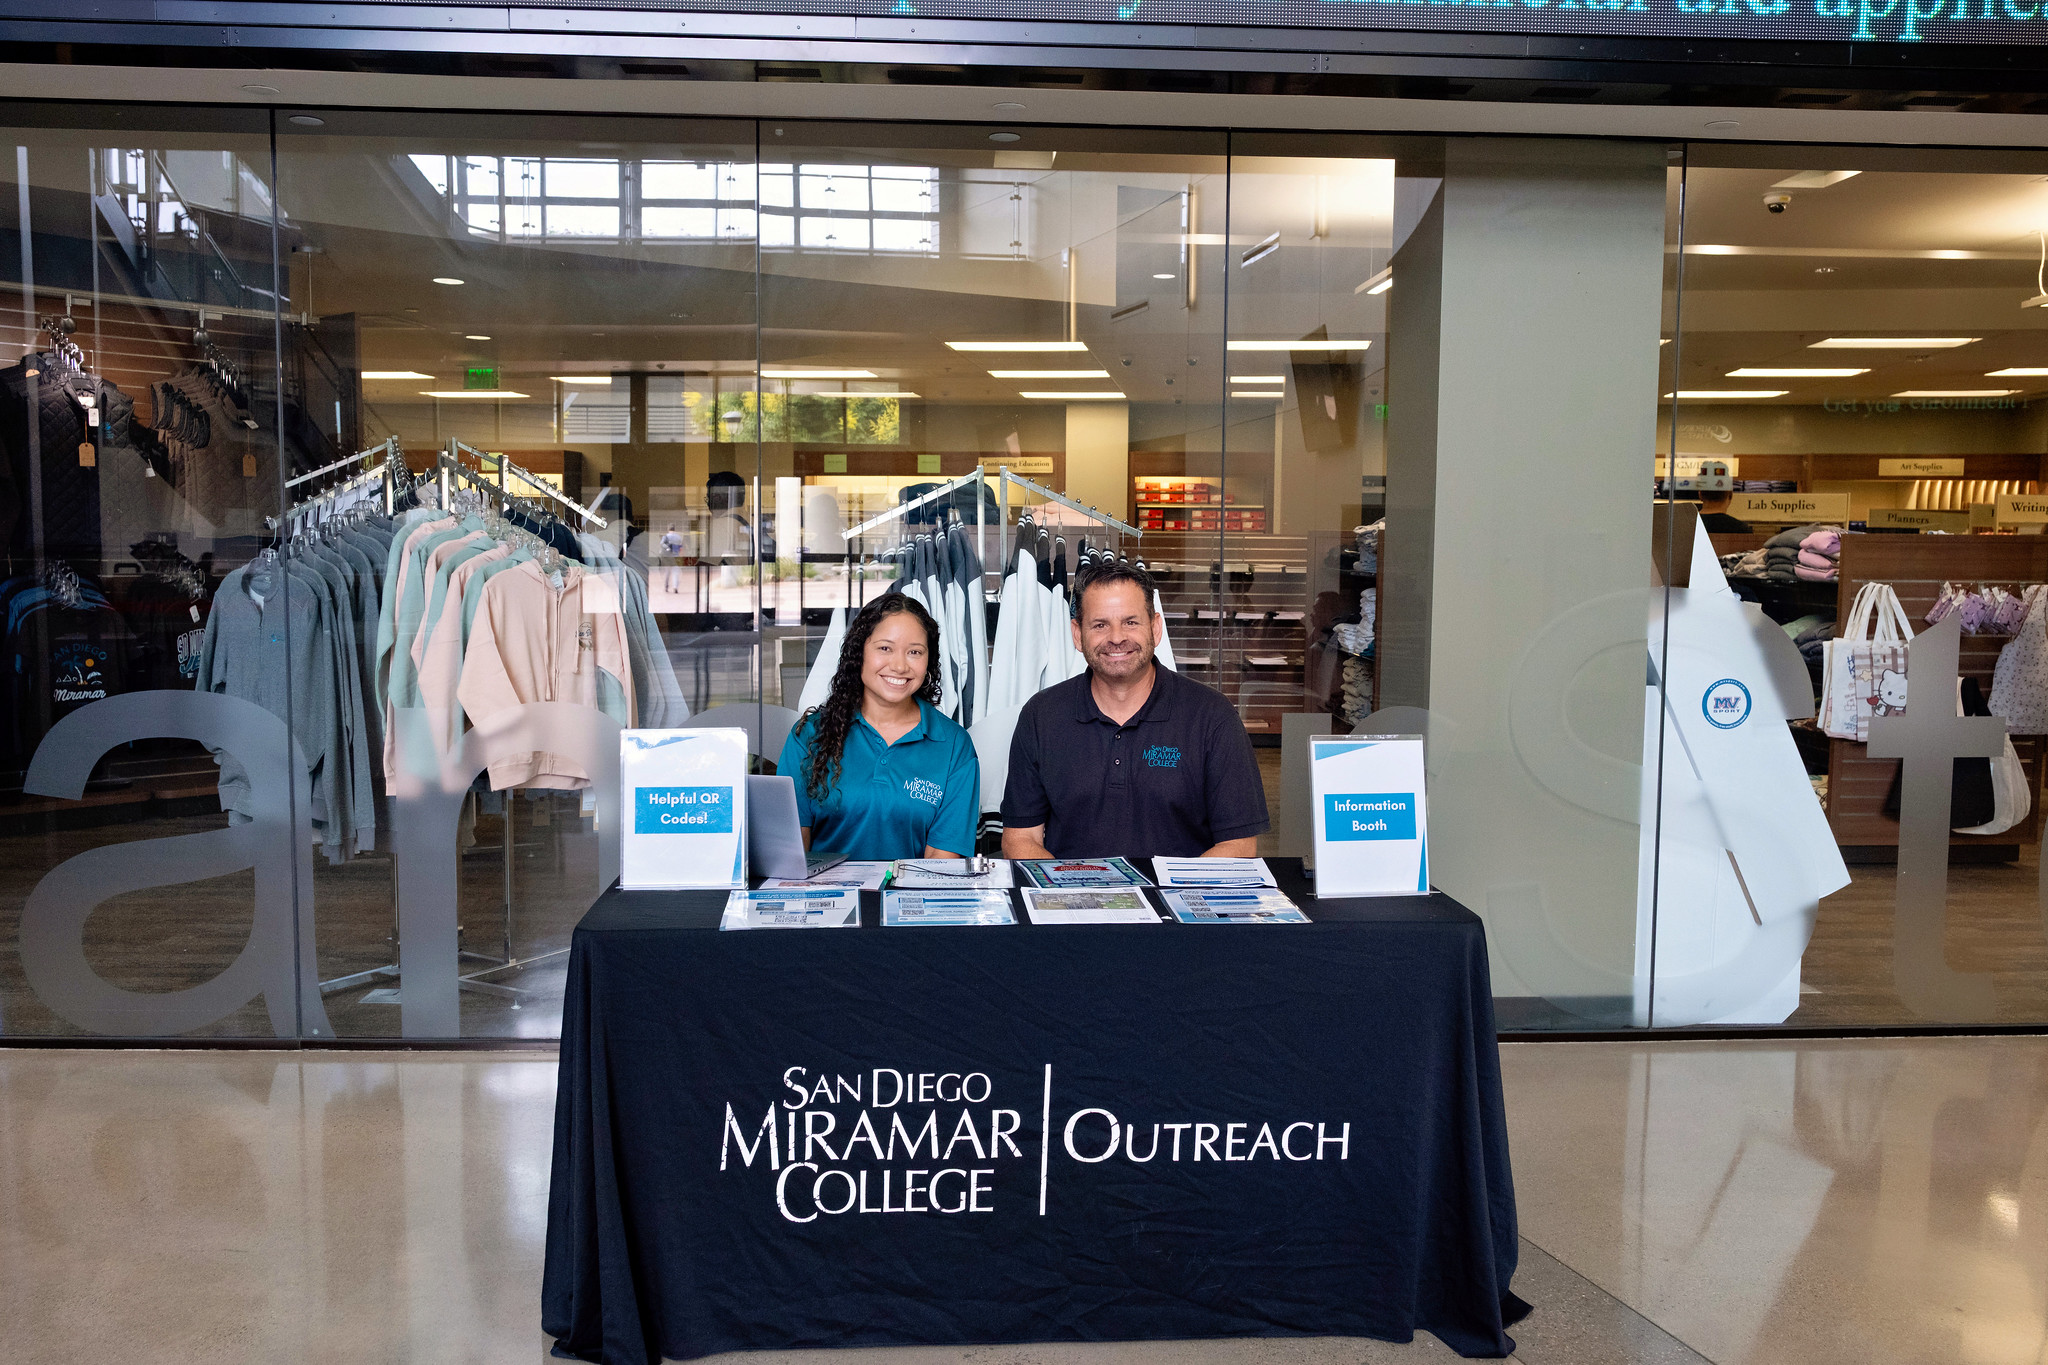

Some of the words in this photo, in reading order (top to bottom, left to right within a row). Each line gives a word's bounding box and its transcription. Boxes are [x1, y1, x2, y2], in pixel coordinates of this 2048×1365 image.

[981, 460, 1018, 469] Continuing
[1018, 460, 1050, 468] Education
[1900, 463, 1911, 471] Art
[1913, 463, 1943, 472] Supplies
[1747, 499, 1767, 510] Lab
[1770, 499, 1816, 513] Supplies
[1887, 513, 1930, 525] Planners
[72, 643, 107, 660] DIEGO
[53, 688, 107, 702] Miramar
[1713, 697, 1741, 709] MV
[1142, 749, 1182, 760] MIRAMAR
[1148, 759, 1178, 768] COLLEGE
[903, 780, 943, 799] MIRAMAR
[914, 776, 925, 785] SAN
[925, 780, 941, 791] DIEGO
[649, 792, 697, 808] Helpful
[700, 792, 720, 804] QR
[910, 790, 938, 806] COLLEGE
[1334, 799, 1406, 812] Information
[660, 812, 708, 825] Codes!
[1352, 818, 1388, 831] Booth
[782, 1066, 862, 1111] SAN
[871, 1068, 992, 1109] DIEGO
[720, 1101, 1022, 1171] MIRAMAR
[1062, 1106, 1351, 1164] OUTREACH
[775, 1161, 995, 1223] COLLEGE
